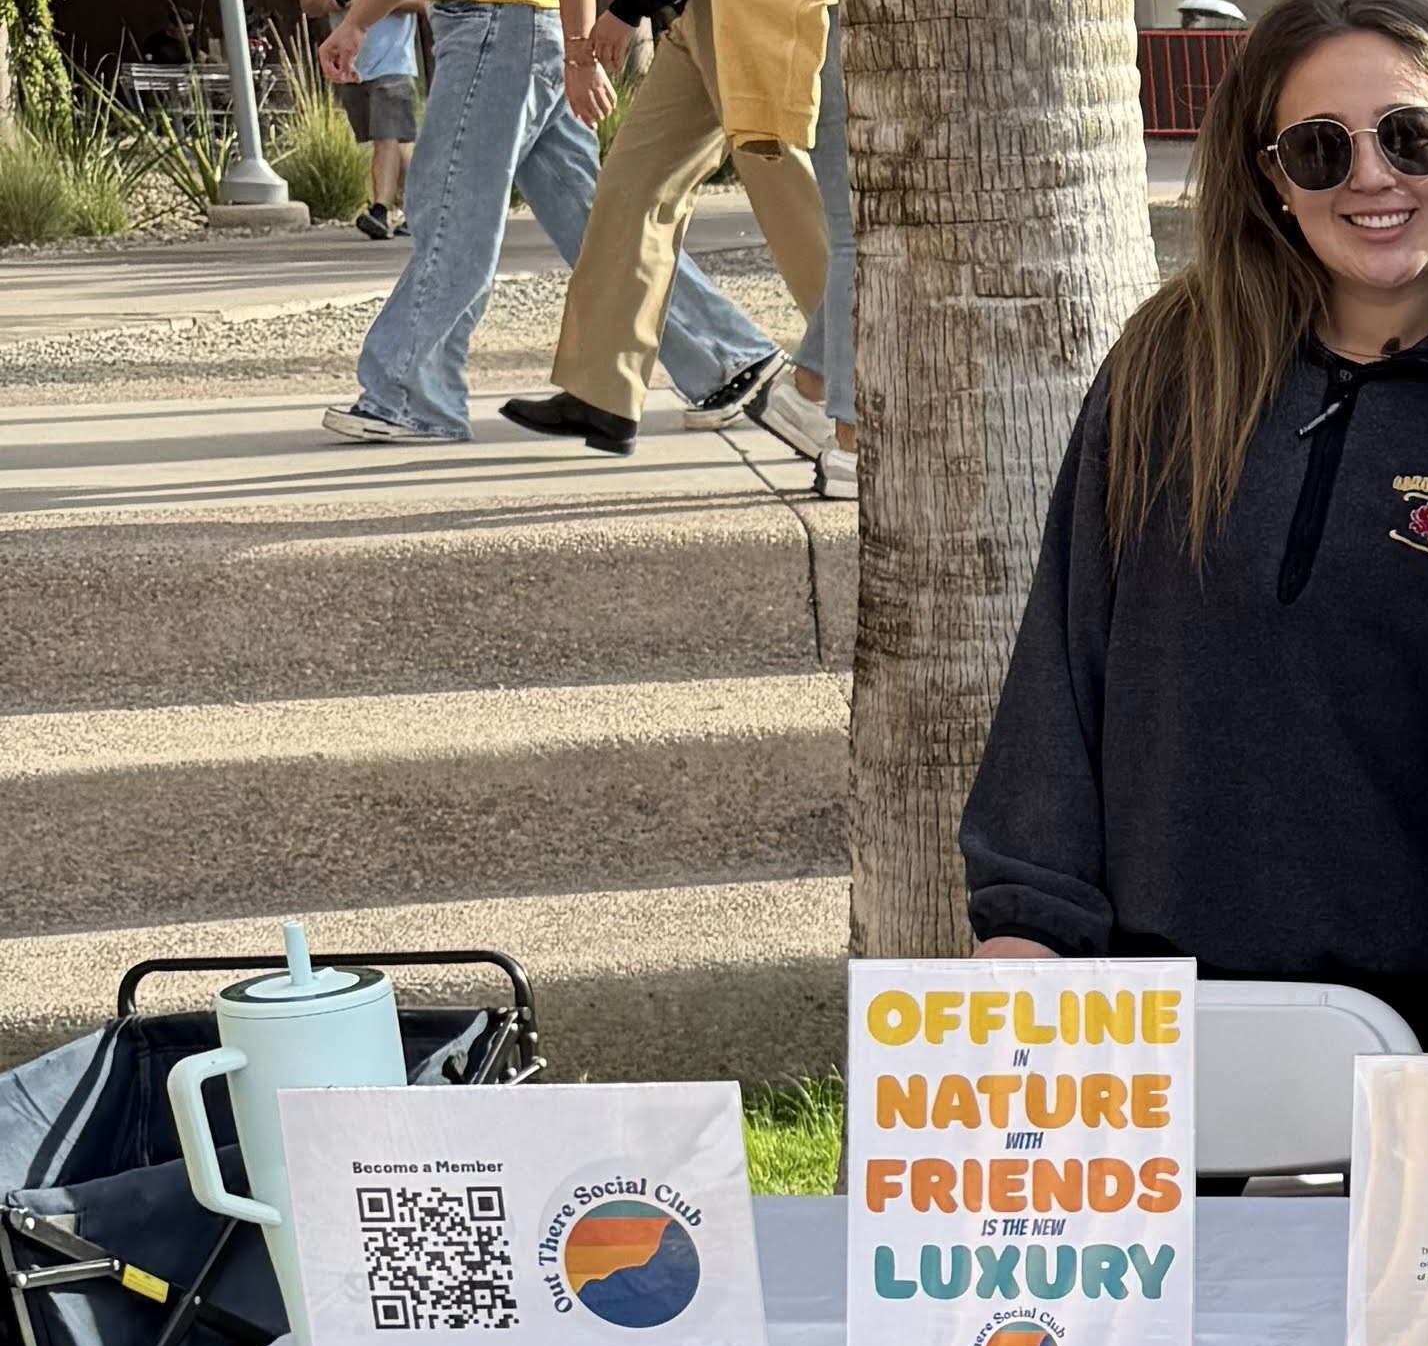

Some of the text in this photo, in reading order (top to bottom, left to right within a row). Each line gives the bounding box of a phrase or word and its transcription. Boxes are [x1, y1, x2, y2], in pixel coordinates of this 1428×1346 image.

[867, 990, 1182, 1045] OFFLINE
[1013, 1049, 1030, 1067] IN
[876, 1073, 1172, 1129] NATURE
[1005, 1132, 1044, 1149] WITH
[352, 1161, 503, 1174] Become a Member
[866, 1157, 1182, 1213] FRIENDS
[538, 1176, 703, 1314] Out There Social Club
[982, 1219, 1065, 1236] IS THE NEW
[874, 1244, 1176, 1300] LUXURY
[993, 1306, 1036, 1324] Social
[1040, 1312, 1065, 1339] Club
